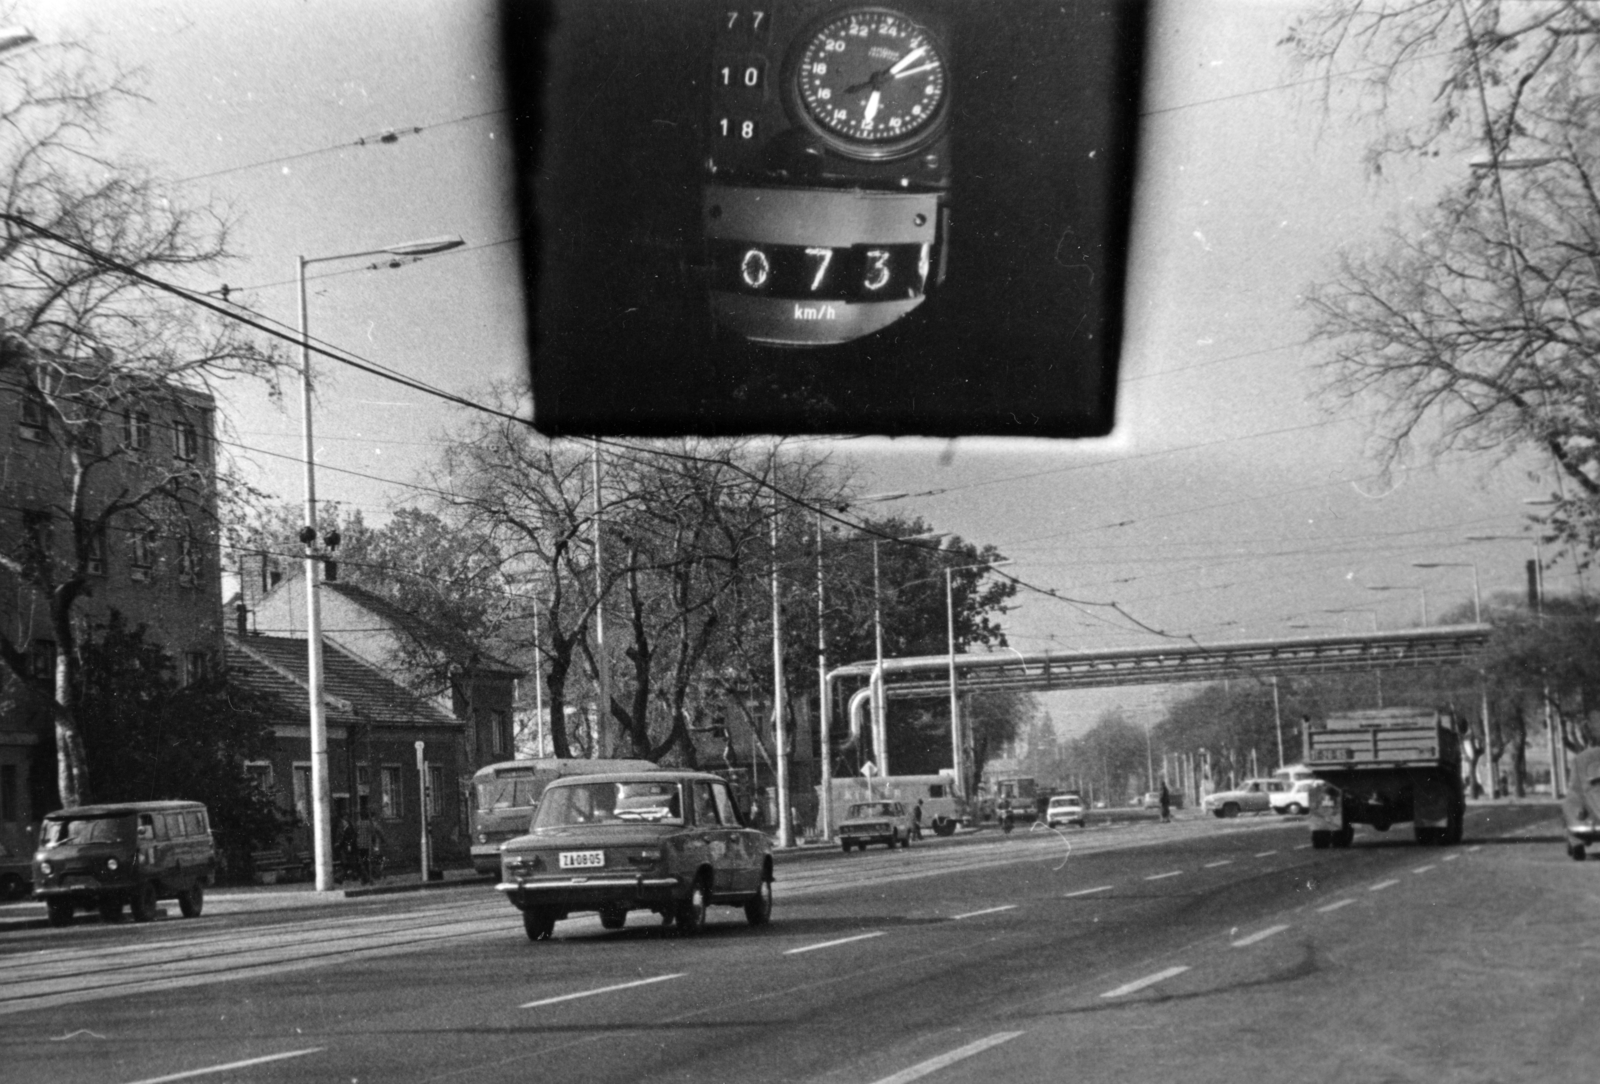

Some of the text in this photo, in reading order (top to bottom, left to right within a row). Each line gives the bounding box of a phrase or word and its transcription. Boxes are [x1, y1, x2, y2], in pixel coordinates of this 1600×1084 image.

[849, 24, 868, 36] 22
[879, 24, 898, 36] 24
[825, 39, 845, 52] 20
[813, 63, 827, 75] 18
[818, 88, 831, 99] 16
[925, 85, 934, 95] 6
[834, 109, 847, 120] 14
[912, 105, 921, 115] 8
[861, 120, 874, 129] 12
[889, 117, 902, 127] 10
[794, 304, 835, 320] km/h
